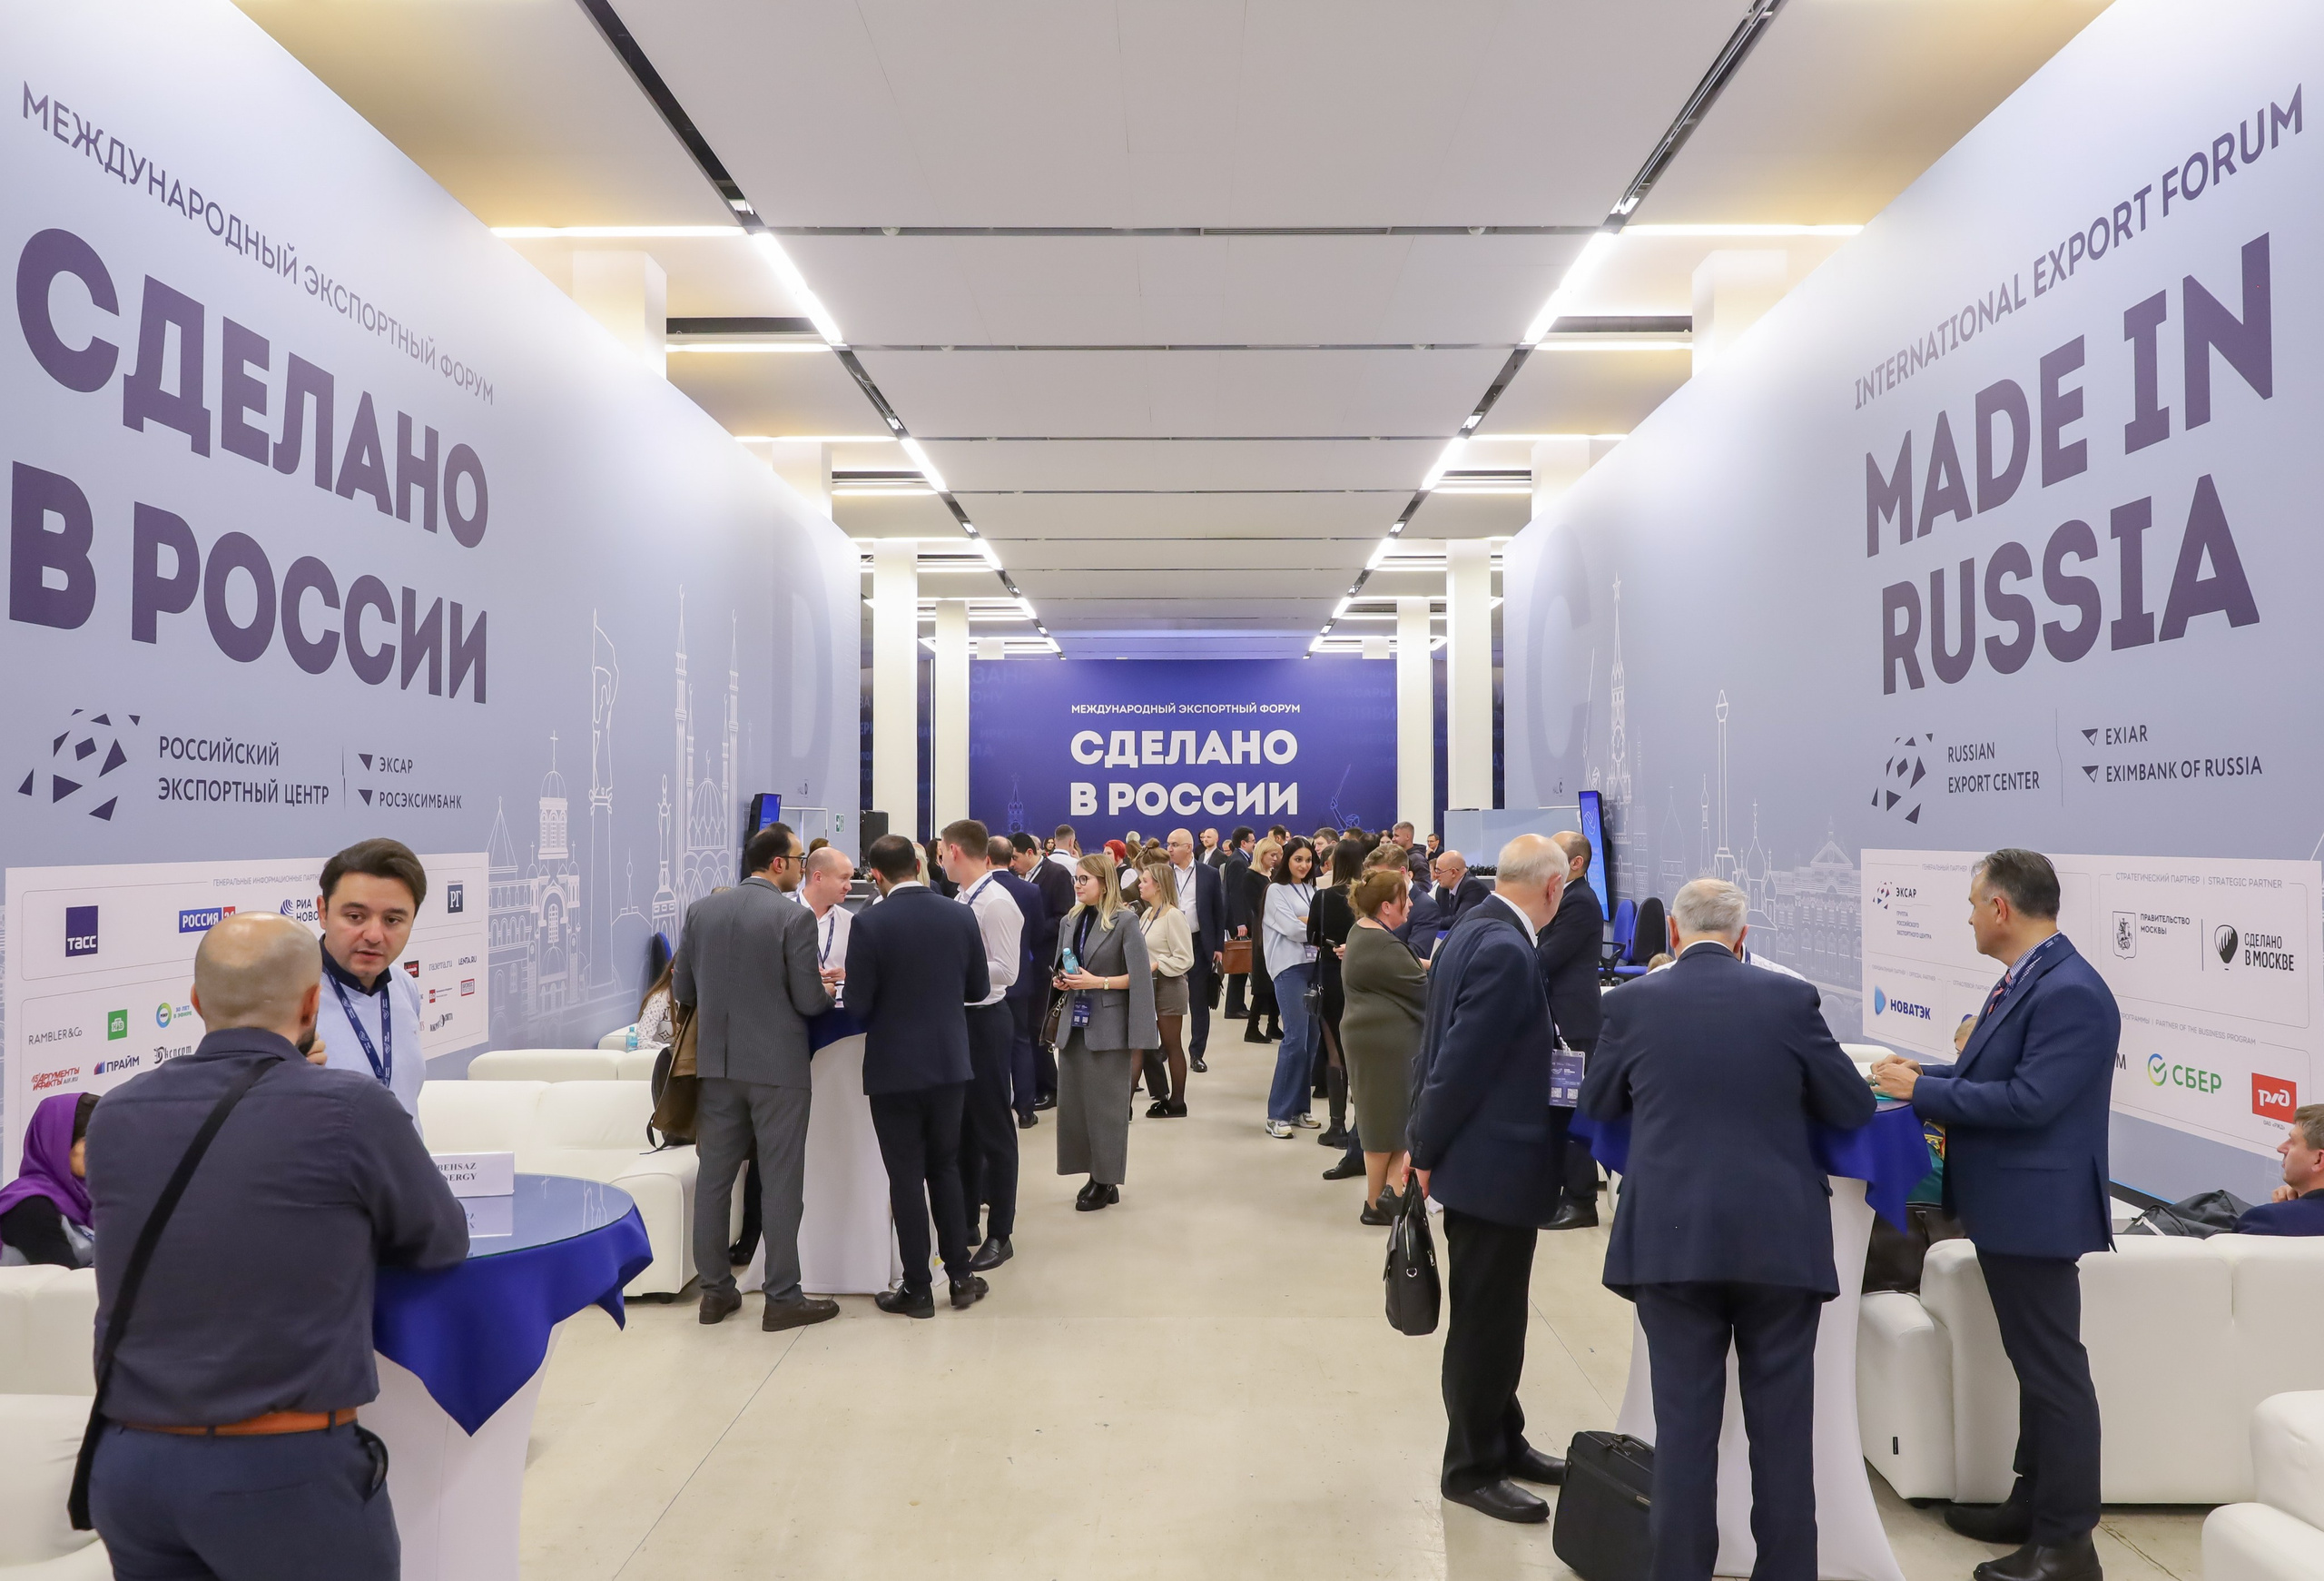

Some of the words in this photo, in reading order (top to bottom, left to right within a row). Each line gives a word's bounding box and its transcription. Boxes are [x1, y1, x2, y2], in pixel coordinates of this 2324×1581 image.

[24, 80, 298, 277] МЕЖДУНАРОДНЫЙ
[304, 264, 437, 371] ЭКСПОРТНЫЙ
[440, 353, 494, 406] ФОРУМ
[1855, 272, 2027, 410] INTERNATIONAL
[2034, 183, 2152, 299] EXPORT
[2162, 83, 2303, 218] FORUM
[16, 228, 488, 548] СДЕЛАНО
[1866, 334, 2088, 558] MADE
[2124, 232, 2273, 455] IN
[9, 460, 96, 630] В
[132, 501, 488, 704] РОССИИ
[1882, 473, 2260, 696] RUSSIA
[1071, 702, 1176, 716] МЕЖДУНАРОДНЫЙ
[1179, 701, 1257, 715] ЭКСПОРТНЫЙ
[1259, 703, 1301, 716] ФОРУМ
[2105, 724, 2148, 745] EXIAR
[159, 735, 280, 766] РОССИЙСКИЙ
[1070, 729, 1299, 768] СДЕЛАНО
[1947, 741, 1995, 764] RUSSIAN
[379, 756, 414, 775] ЭКСАР
[2106, 763, 2177, 783] EXIMBANK
[2181, 759, 2201, 779] OF
[2204, 755, 2263, 778] RUSSIA
[158, 778, 278, 805] ЭКСПОРТНЫЙ
[284, 784, 330, 808] ЦЕНТР
[1948, 774, 1991, 794] EXPORT
[1993, 771, 2040, 792] CENTER
[379, 789, 462, 810] РОСЭКСИМБАНК
[1070, 782, 1098, 816] В
[1108, 781, 1298, 816] РОССИИ
[213, 876, 251, 886] ГЕНЕРАЛЬНЫЕ
[252, 874, 302, 884] ИНФОРМАЦИОННЫЕ
[2115, 872, 2170, 884] СТРАТЕГИЧЕСКИЙ
[2171, 874, 2201, 884] ПАРТНЕР
[2208, 876, 2247, 887] STRATEGIC
[2249, 878, 2283, 889] PARTNER
[449, 890, 461, 907] РГ
[1896, 887, 1917, 898] ЭКСАР
[296, 898, 311, 909] РИА
[182, 911, 219, 928] РОССИЯ
[2141, 914, 2191, 924] ПРАВИТЕЛЬСТВО
[2141, 925, 2167, 935] МОСКВЫ
[2244, 933, 2282, 949] СДЕЛАНО
[2245, 950, 2251, 966] В
[2253, 951, 2294, 972] МОСКВЕ
[1890, 999, 1931, 1020] НОВАТЭК
[2155, 1019, 2179, 1031] PARTNER
[2188, 1025, 2198, 1034] THE
[2198, 1027, 2226, 1040] BUSINESS
[2227, 1033, 2257, 1045] PROGRAM
[106, 1054, 140, 1073] ПРАЙМ
[2172, 1064, 2222, 1094] СБЕР
[438, 1162, 477, 1171] BEHSAZ
